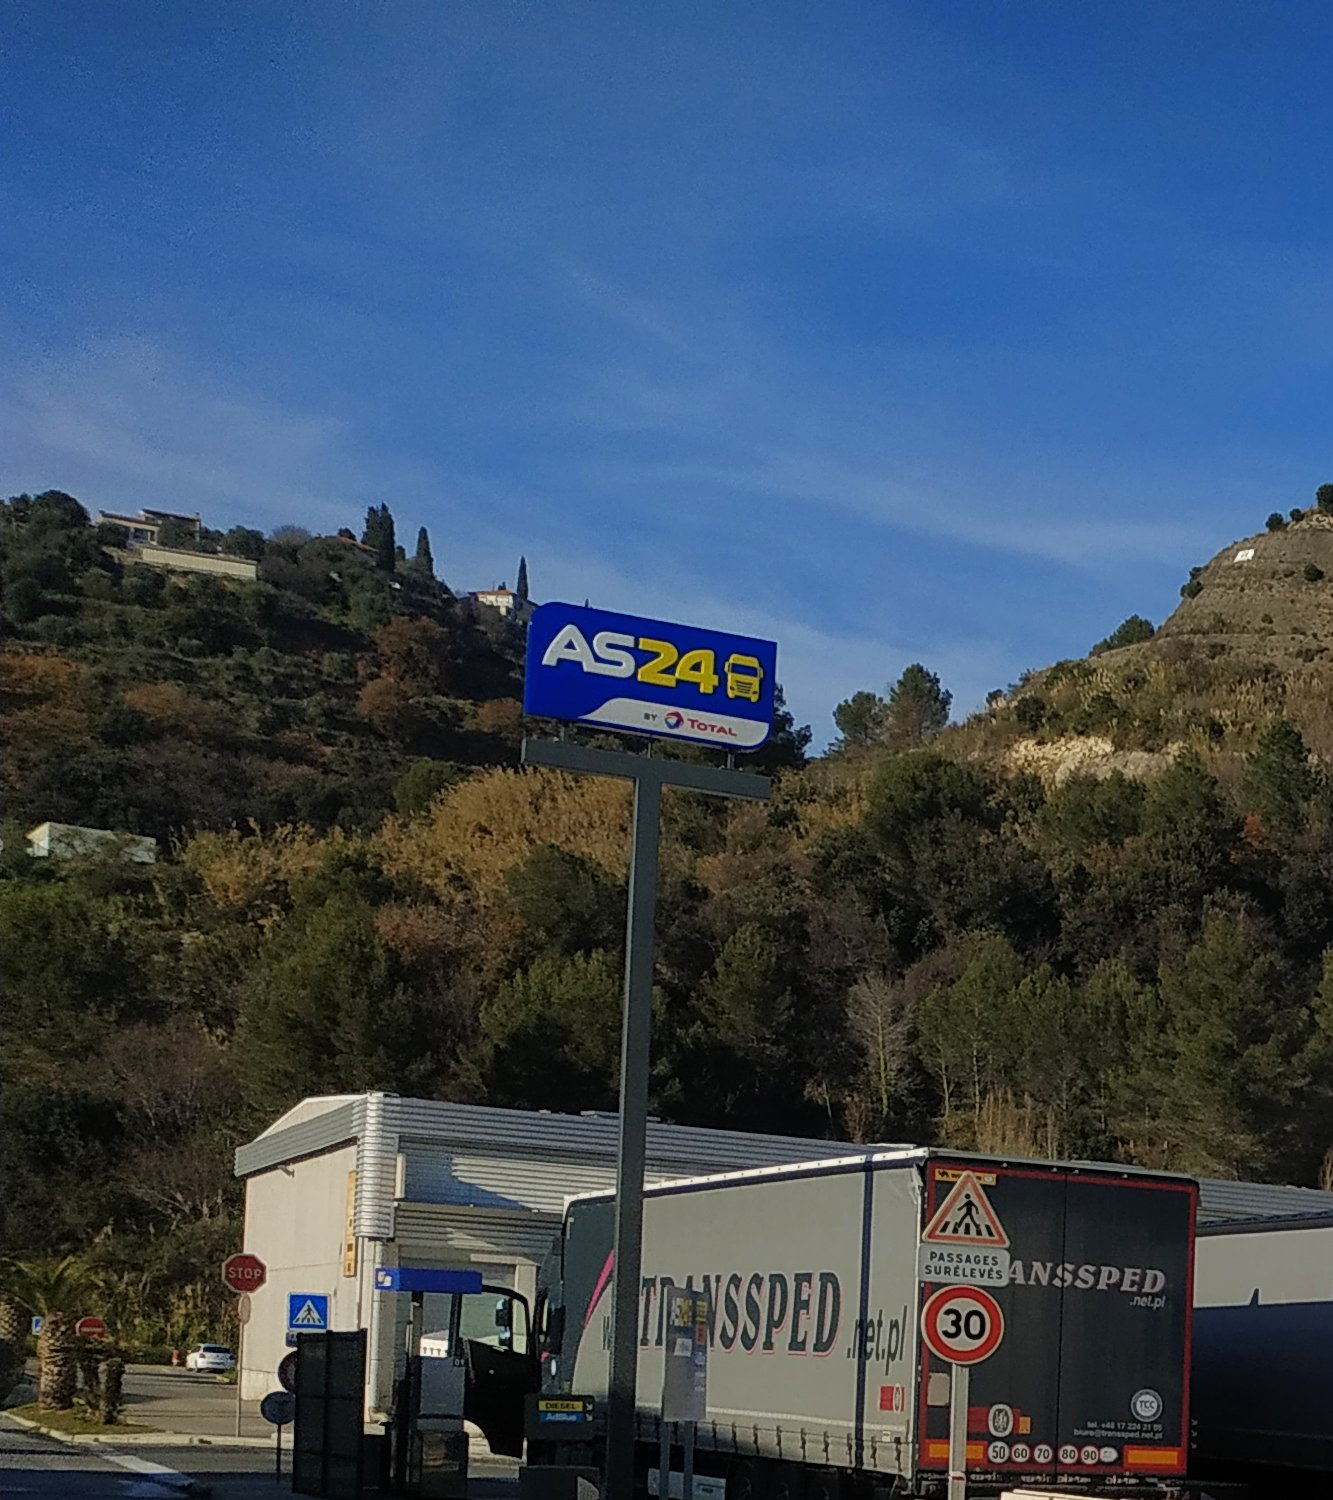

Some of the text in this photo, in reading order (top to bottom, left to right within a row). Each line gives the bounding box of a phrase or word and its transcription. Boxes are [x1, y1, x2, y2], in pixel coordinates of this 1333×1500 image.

[541, 624, 719, 694] AS24
[643, 712, 738, 738] BY TOTAL
[929, 1251, 999, 1267] PASSAGES
[227, 1268, 263, 1279] STOP
[924, 1264, 1004, 1280] SURÉLEVÉS
[1009, 1259, 1167, 1294] ANSSPED
[1129, 1294, 1167, 1309] .net.pl
[941, 1308, 986, 1340] 30
[545, 1402, 577, 1411] DIESEL
[992, 1445, 1006, 1459] 50
[1013, 1447, 1028, 1459] 60
[1036, 1448, 1050, 1460] 70
[1061, 1448, 1076, 1460] 80
[1083, 1449, 1097, 1461] 90
